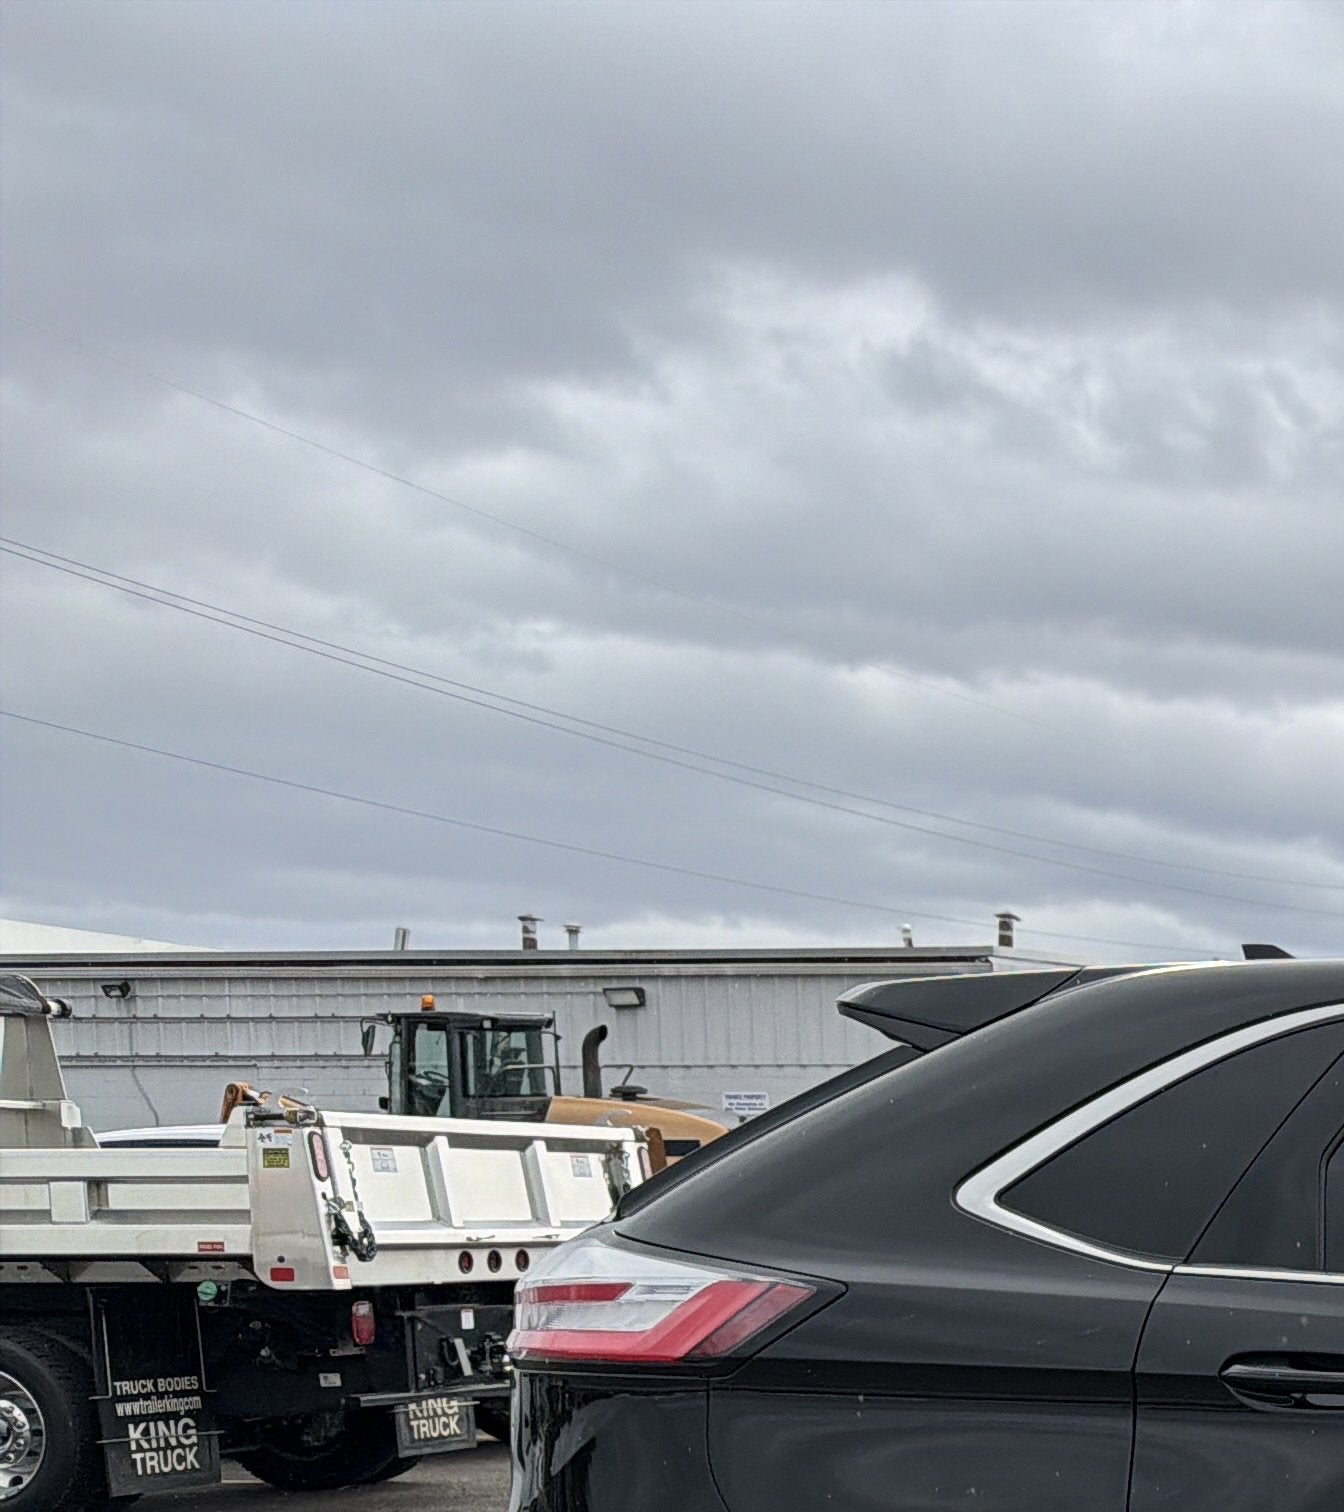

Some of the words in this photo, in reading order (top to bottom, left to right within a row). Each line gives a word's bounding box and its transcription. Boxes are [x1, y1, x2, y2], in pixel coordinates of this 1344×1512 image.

[113, 1379, 155, 1396] TRUCK
[157, 1376, 199, 1392] BODIES
[128, 1417, 198, 1451] KING
[409, 1415, 461, 1440] TRUCK
[131, 1446, 200, 1476] TRUCK
